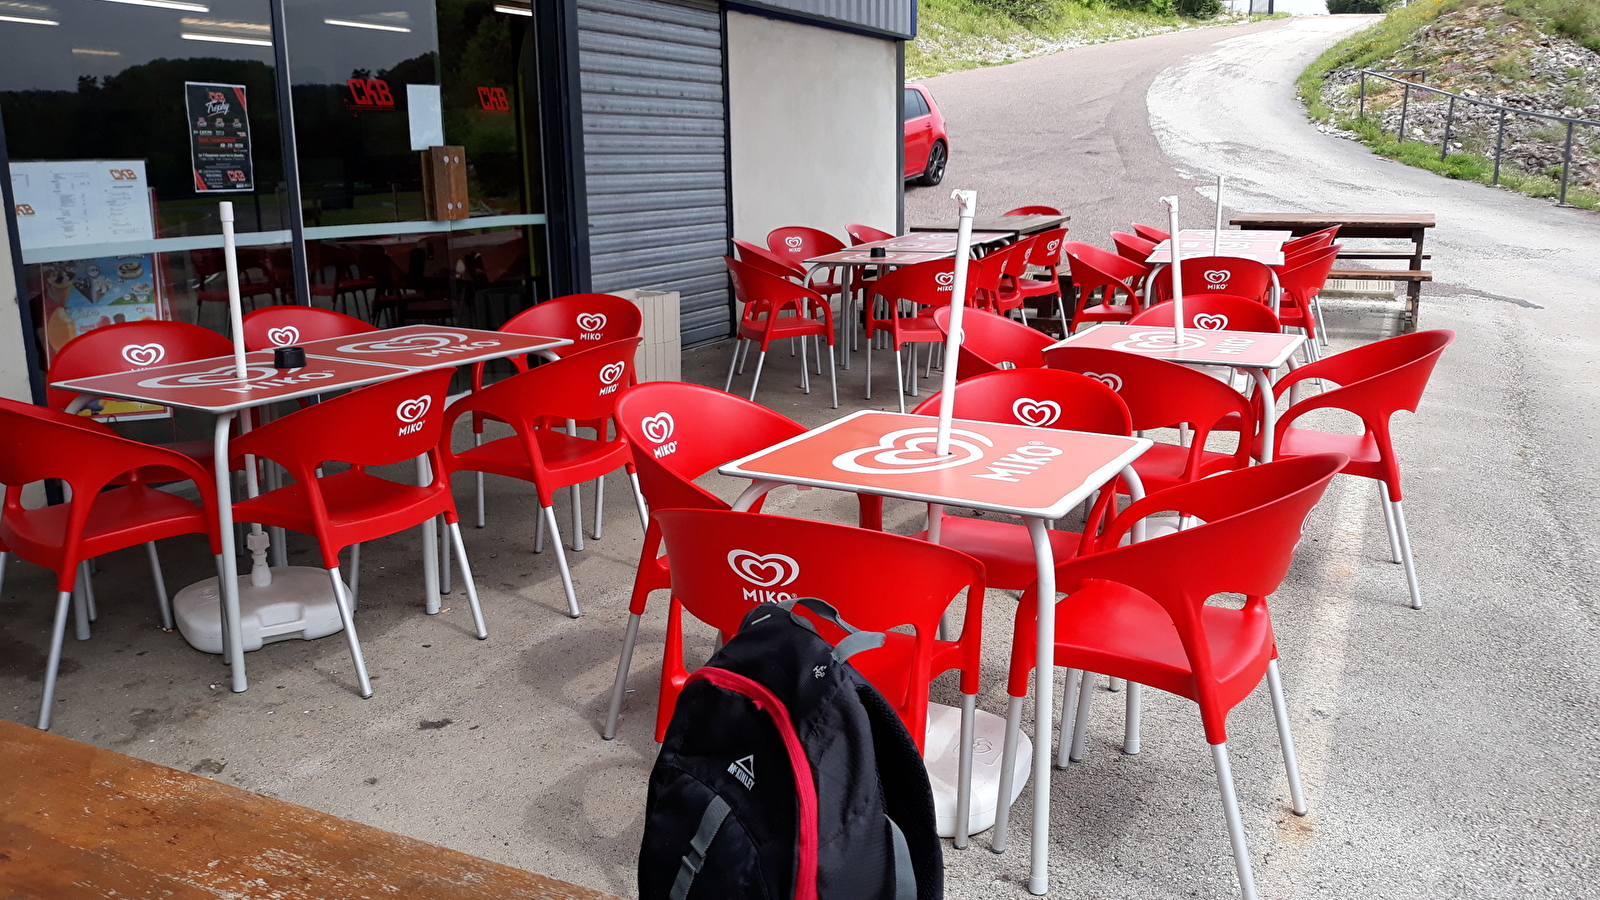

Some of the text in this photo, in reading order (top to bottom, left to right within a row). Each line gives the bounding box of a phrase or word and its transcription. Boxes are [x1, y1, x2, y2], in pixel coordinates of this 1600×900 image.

[347, 79, 395, 106] CKB
[477, 86, 510, 111] CKB
[205, 101, 230, 116] Trophy
[109, 169, 138, 180] CKB
[14, 204, 36, 216] KB
[580, 333, 601, 344] MIKO
[413, 341, 502, 357] MIKO
[220, 372, 335, 393] MIKO
[599, 384, 618, 396] MIKO
[398, 421, 424, 437] MIKO
[653, 442, 677, 459] MIKO
[969, 444, 1064, 483] MIKO
[742, 587, 792, 604] MIKO
